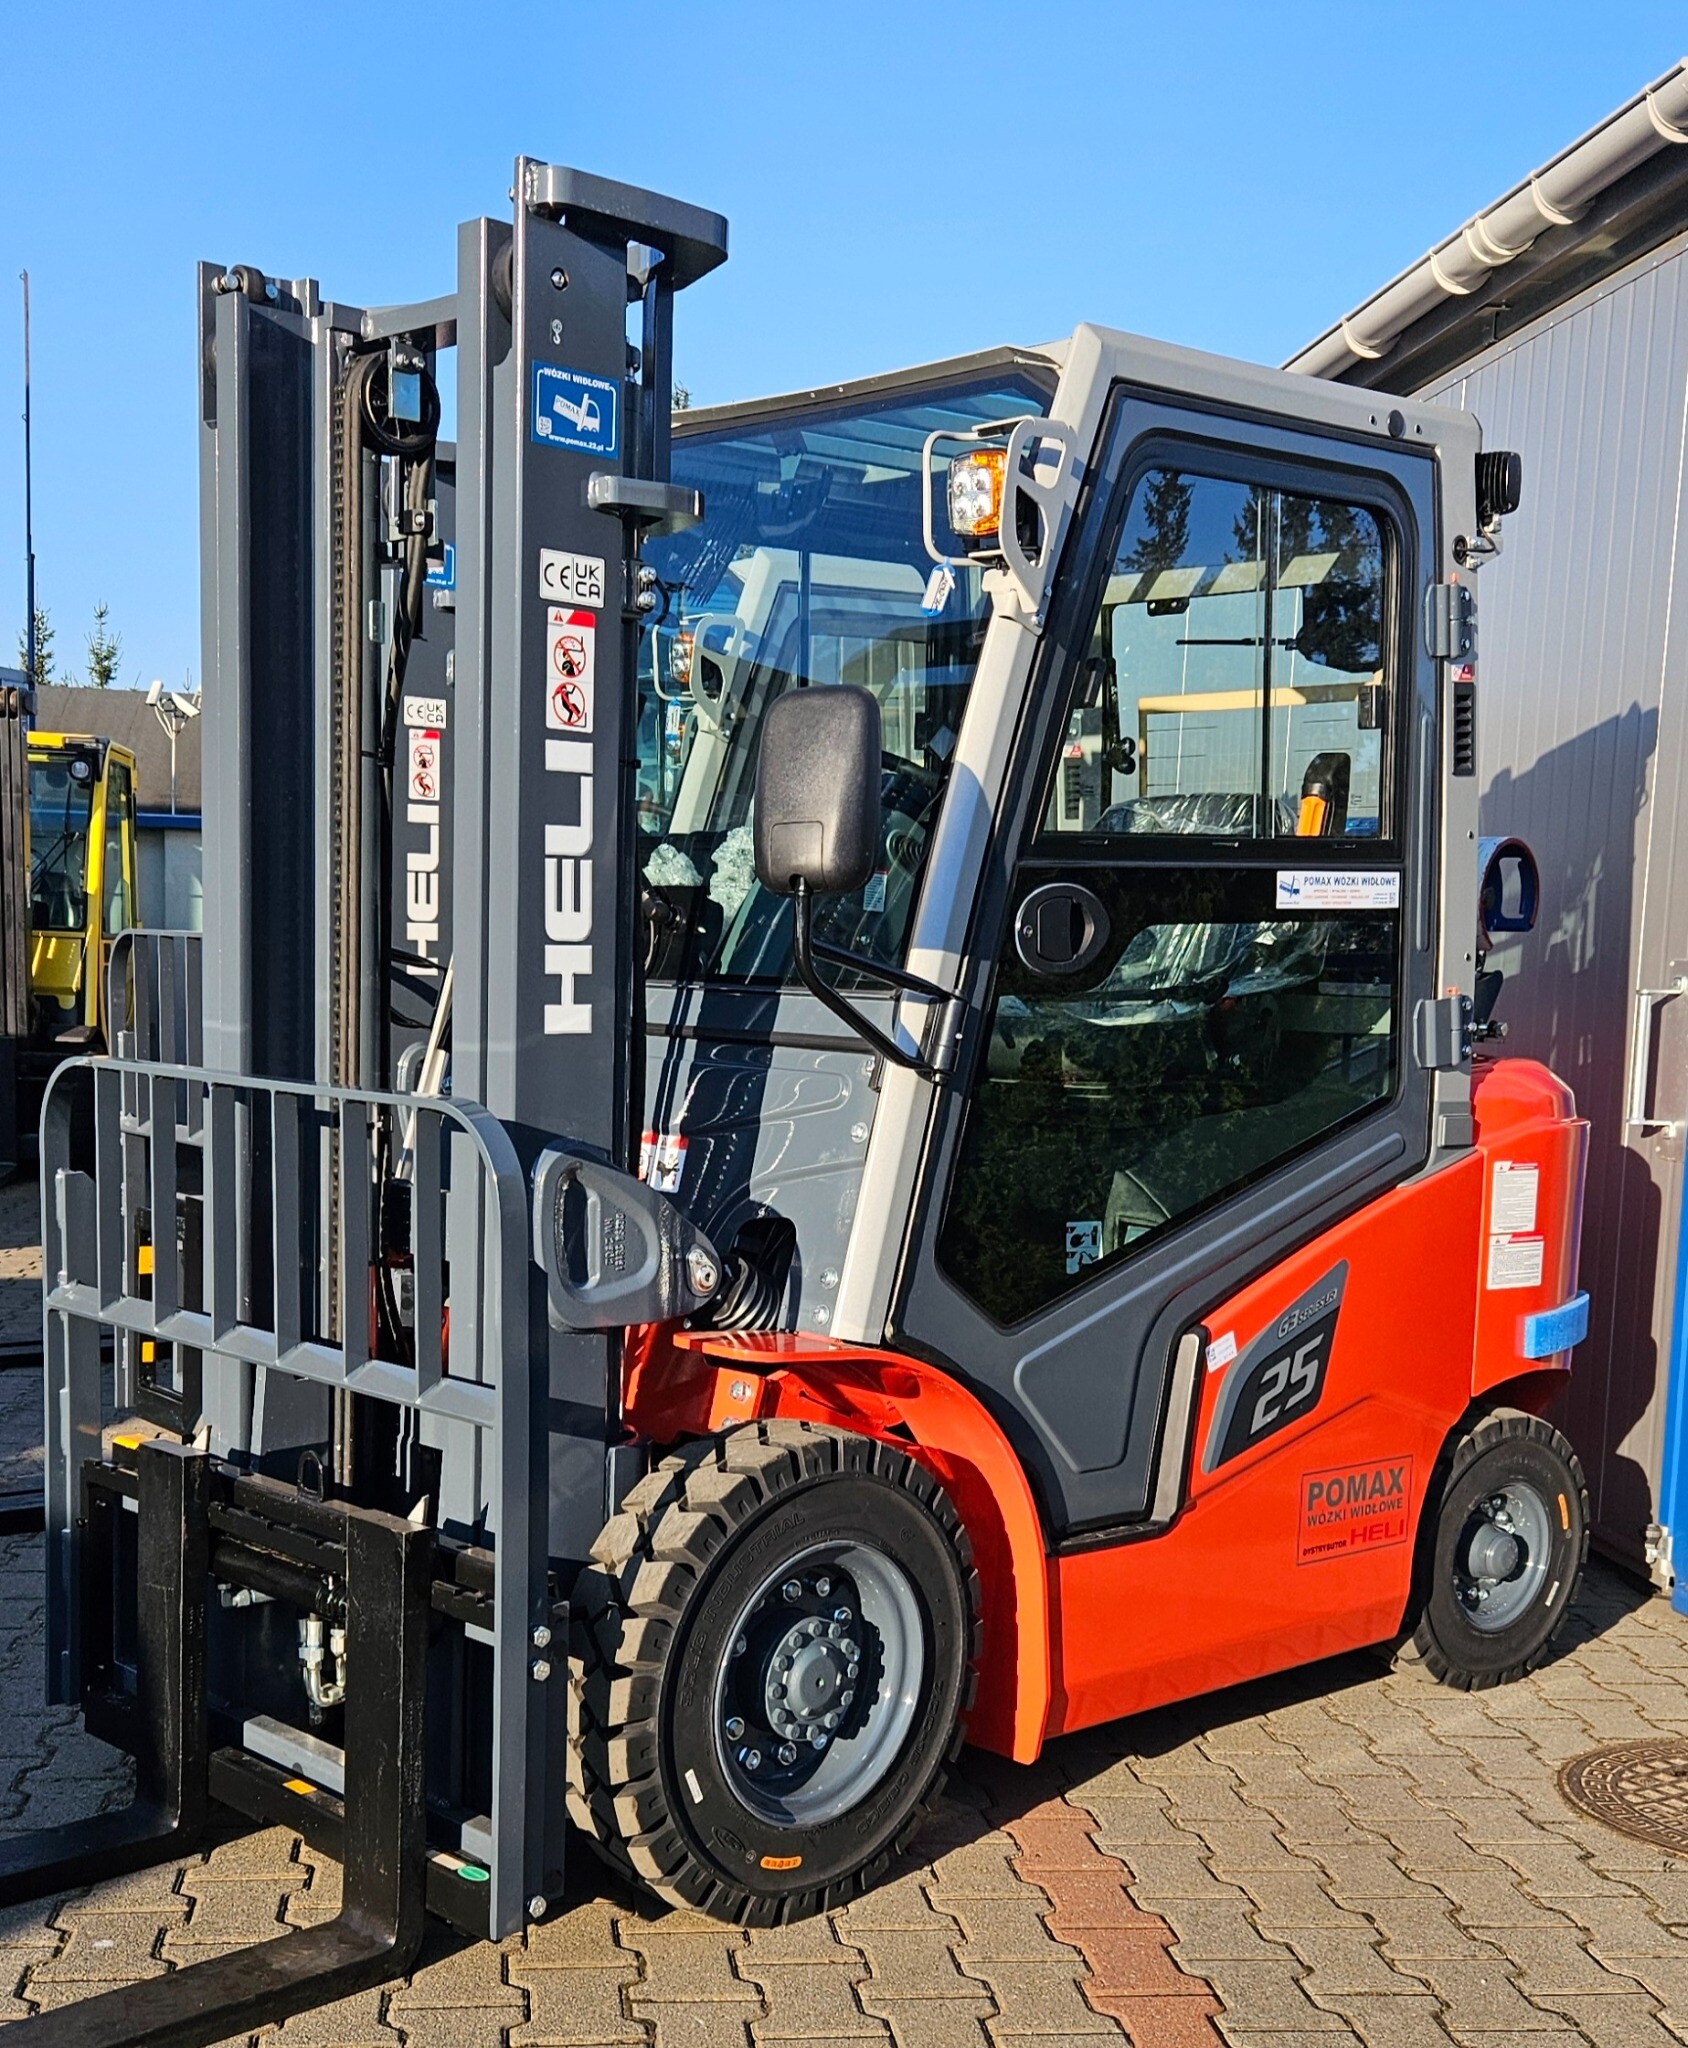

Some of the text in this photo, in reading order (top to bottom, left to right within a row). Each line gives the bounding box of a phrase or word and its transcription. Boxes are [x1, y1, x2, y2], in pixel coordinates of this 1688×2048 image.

[543, 367, 610, 391] WÓZKI WIDŁOWE
[544, 562, 570, 590] CE
[576, 562, 600, 582] UK
[576, 581, 601, 599] CA
[406, 803, 440, 976] HELI
[544, 739, 593, 1034] HELI
[1304, 876, 1332, 886] POMAX
[1361, 876, 1397, 886] WIDŁOWE
[1251, 1333, 1324, 1435] 25
[1308, 1466, 1404, 1512] POMAX
[1307, 1497, 1403, 1528] WÓZKI WIDŁOWE
[1303, 1519, 1404, 1556] DYSTRYBUTOR HELI
[703, 1513, 806, 1624] INDUSTRIAL
